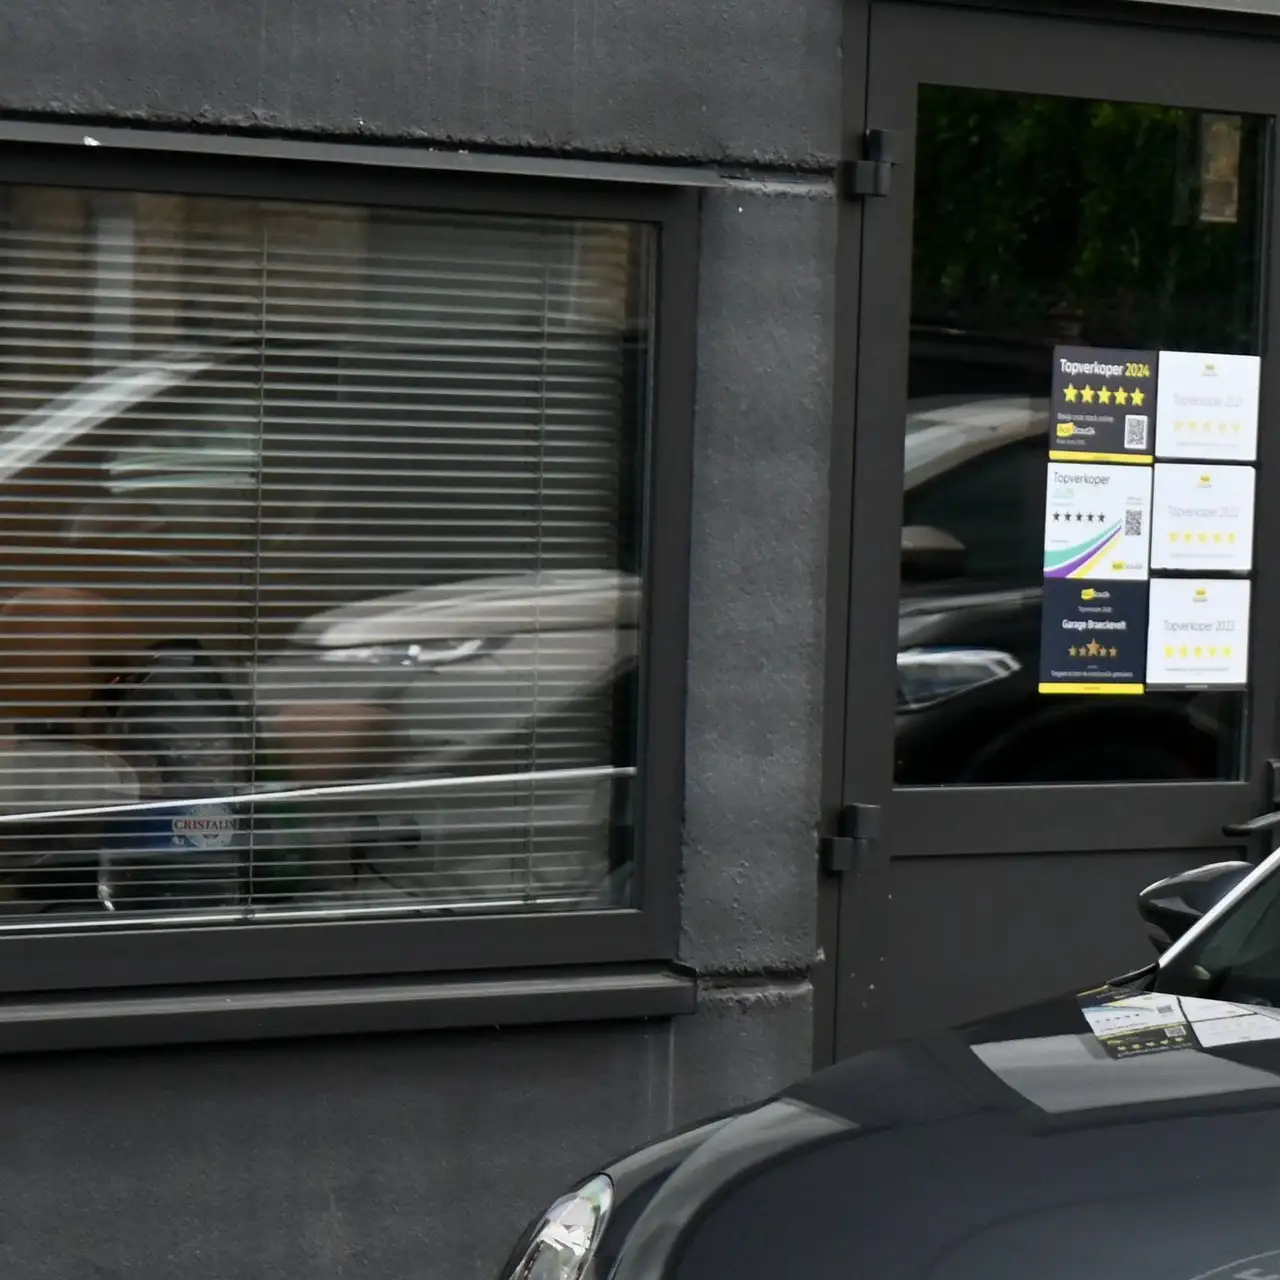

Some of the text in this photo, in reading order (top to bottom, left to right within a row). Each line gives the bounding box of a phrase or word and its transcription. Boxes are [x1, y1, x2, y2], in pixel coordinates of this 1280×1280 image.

[1059, 358, 1150, 379] Topverkoper 2024
[1053, 471, 1111, 486] Topverkoper
[1061, 619, 1087, 631] Garage
